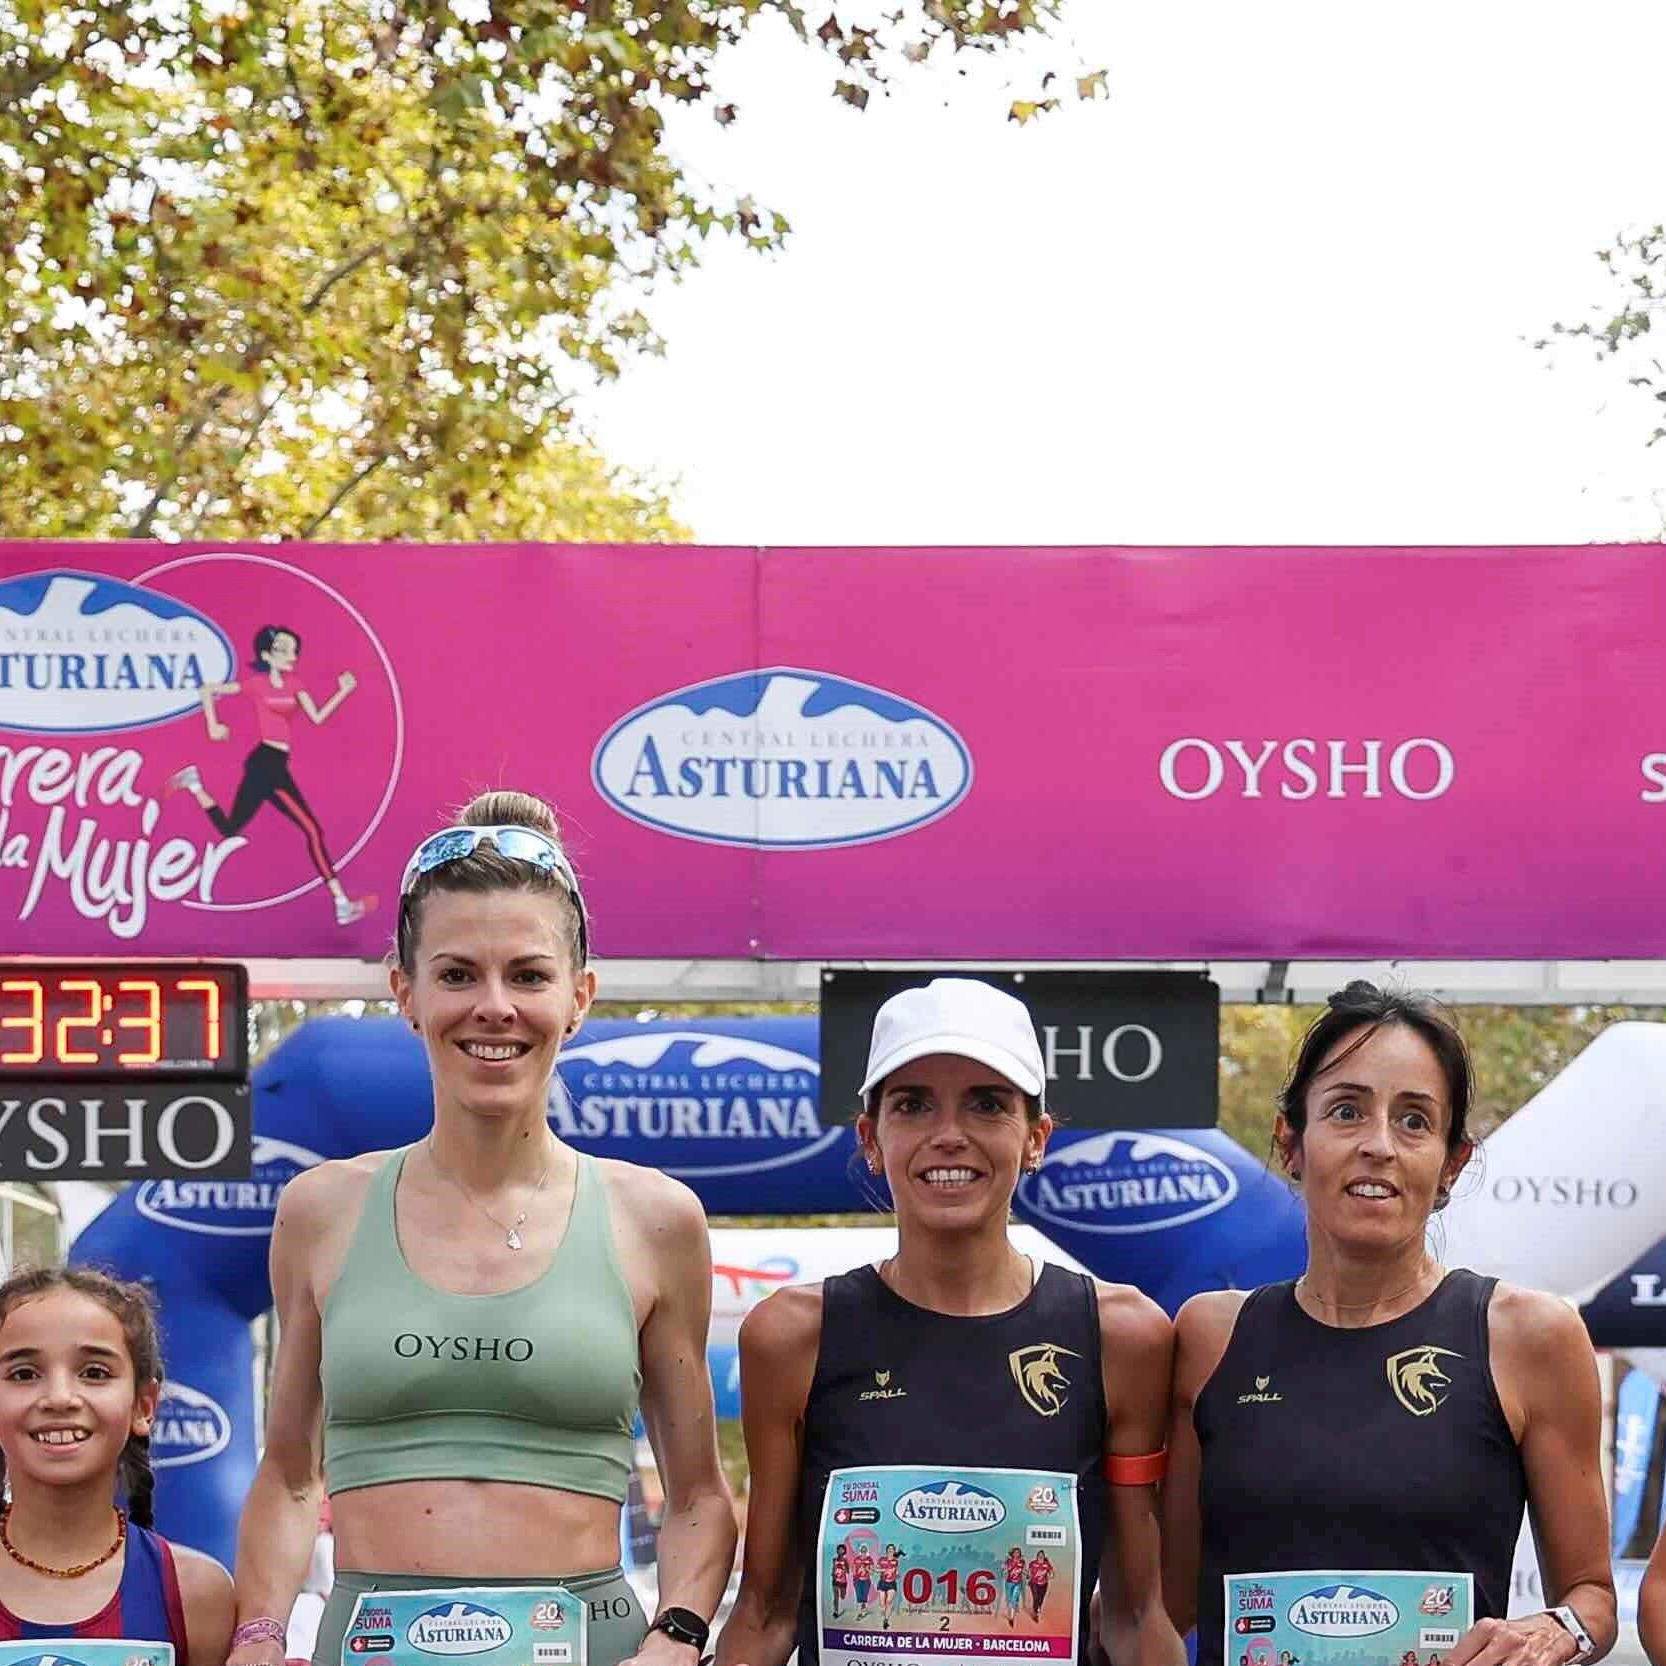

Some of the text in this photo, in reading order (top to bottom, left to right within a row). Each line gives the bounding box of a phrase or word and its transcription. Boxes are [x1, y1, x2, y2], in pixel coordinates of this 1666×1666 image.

[682, 730, 930, 748] CENTRAL LECHERA
[625, 733, 941, 799] ASTURIANA
[1158, 738, 1455, 801] OYSHO
[18, 800, 249, 938] Mujer
[583, 1072, 810, 1091] CENTRAL LECHERA
[545, 1080, 822, 1139] ASTURIANA
[1036, 1173, 1223, 1212] ASTURIANA
[1492, 1176, 1639, 1210] OYSHO
[393, 1333, 534, 1362] OYSHO
[841, 1490, 878, 1503] SUMA
[1033, 1487, 1053, 1502] 20
[902, 1501, 998, 1522] ASTURIANA
[903, 1568, 997, 1606] 016
[536, 1604, 558, 1621] 20
[1238, 1597, 1274, 1611] SUMA
[355, 1615, 393, 1631] SUMA
[940, 1616, 950, 1631] 2
[1295, 1604, 1391, 1626] ASTURIANA
[413, 1622, 505, 1645] ASTURIANA
[844, 1633, 1051, 1653] CARRERA DE LA MUJER BARCELONA
